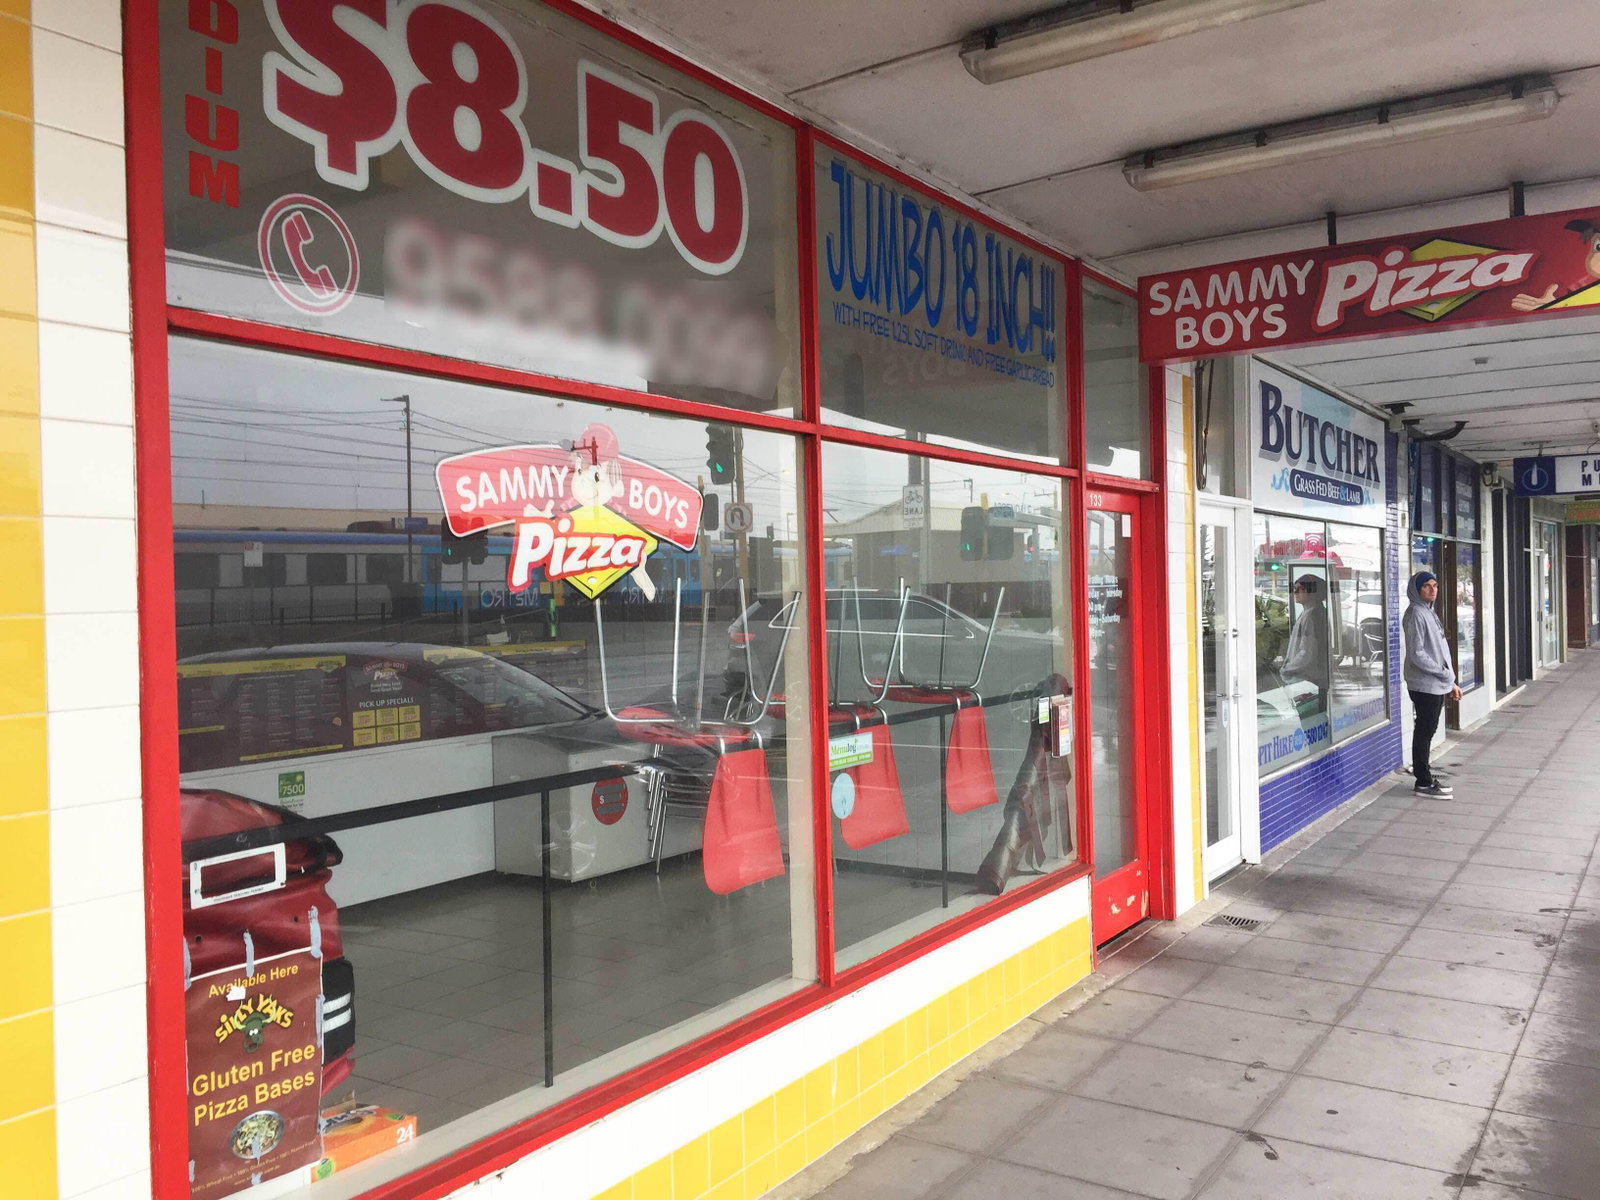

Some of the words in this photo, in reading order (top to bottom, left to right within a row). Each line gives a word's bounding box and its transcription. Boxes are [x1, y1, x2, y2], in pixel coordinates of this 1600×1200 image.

[263, 0, 749, 274] $8.50
[826, 158, 945, 328] JUMBO
[952, 220, 981, 338] 18
[1148, 258, 1315, 317] SAMMY
[1315, 249, 1536, 329] Pizza
[833, 302, 861, 329] WITH
[863, 311, 890, 338] FREE
[914, 328, 938, 353] SOFT
[968, 346, 984, 367] AND
[985, 352, 1005, 374] FREE
[1175, 303, 1288, 351] BOYS
[1259, 379, 1381, 485] BUTCHER
[456, 465, 569, 513] SAMMY
[629, 478, 689, 530] BOYS
[1089, 493, 1102, 507] 133
[1294, 473, 1316, 495] GRASS
[1316, 479, 1327, 497] FED
[1327, 481, 1340, 500] BEEF
[1347, 487, 1361, 505] LAMB
[510, 516, 646, 589] Pizza
[359, 700, 375, 709] PICK
[375, 699, 386, 707] UP
[386, 696, 414, 706] SPECIALS
[281, 783, 305, 796] 7500
[269, 964, 299, 981] Here
[192, 1059, 264, 1097] Gluten
[271, 1044, 316, 1072] Free
[194, 1096, 249, 1126] Pizza
[255, 1071, 315, 1105] Bases
[395, 1123, 414, 1145] 24
